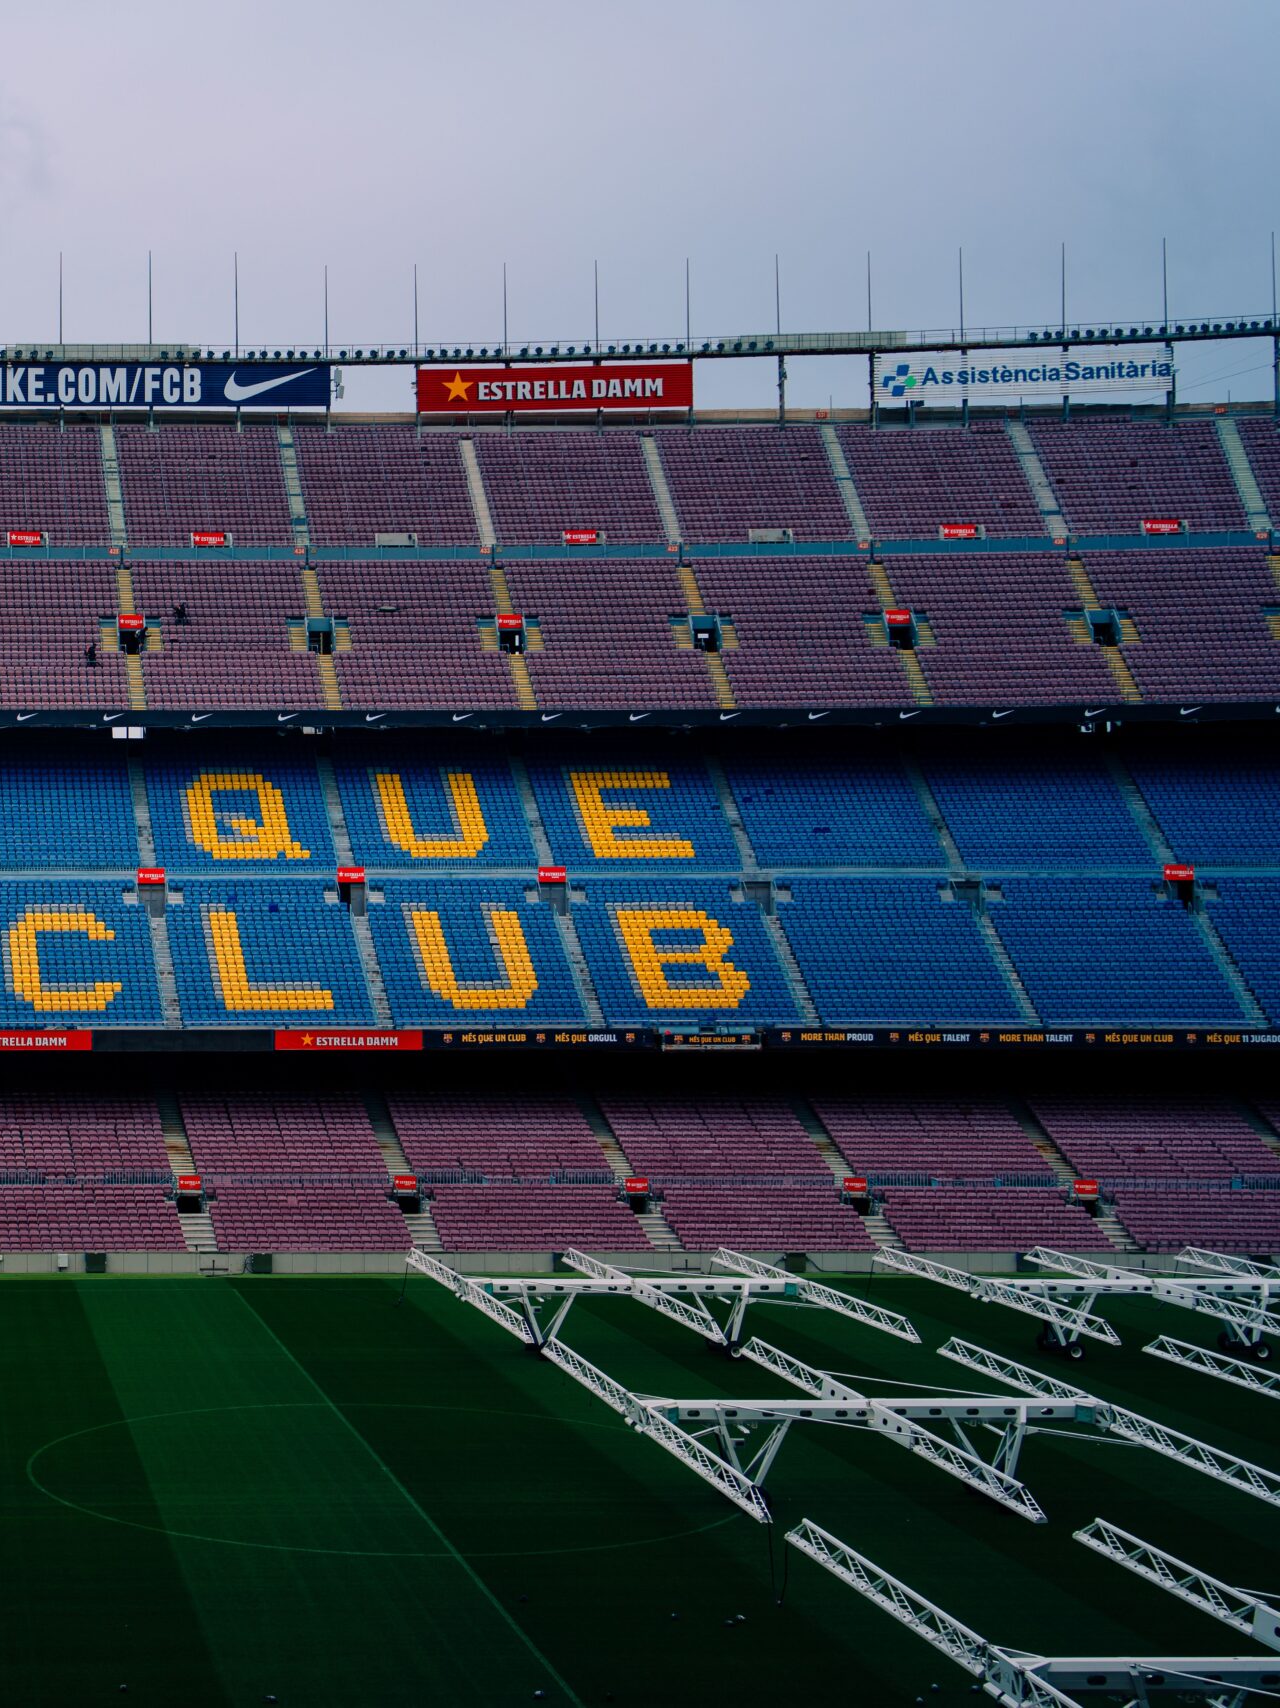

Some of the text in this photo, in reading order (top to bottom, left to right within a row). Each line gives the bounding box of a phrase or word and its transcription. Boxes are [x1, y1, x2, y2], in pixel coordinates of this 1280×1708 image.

[921, 360, 1172, 385] Assistència Sanitària
[477, 377, 664, 401] ESTRELLA DAMM
[184, 772, 696, 860] QUE
[8, 910, 752, 1012] CLUB
[35, 1037, 67, 1046] DAMM
[316, 1037, 399, 1046] ESTRELLA DAMM
[462, 1033, 476, 1042] MÉS
[478, 1034, 493, 1043] QUE
[495, 1034, 506, 1042] UN
[555, 1033, 616, 1043] MÉS QUE ORGULL
[847, 1033, 873, 1041] PROUD
[909, 1033, 923, 1041] MÉS
[925, 1034, 940, 1043] QUE
[1046, 1034, 1072, 1042] TALENT
[1106, 1033, 1120, 1042] MÉS
[1123, 1035, 1138, 1044] QUE
[1207, 1033, 1222, 1042] MÉS
[1224, 1035, 1240, 1044] QUE
